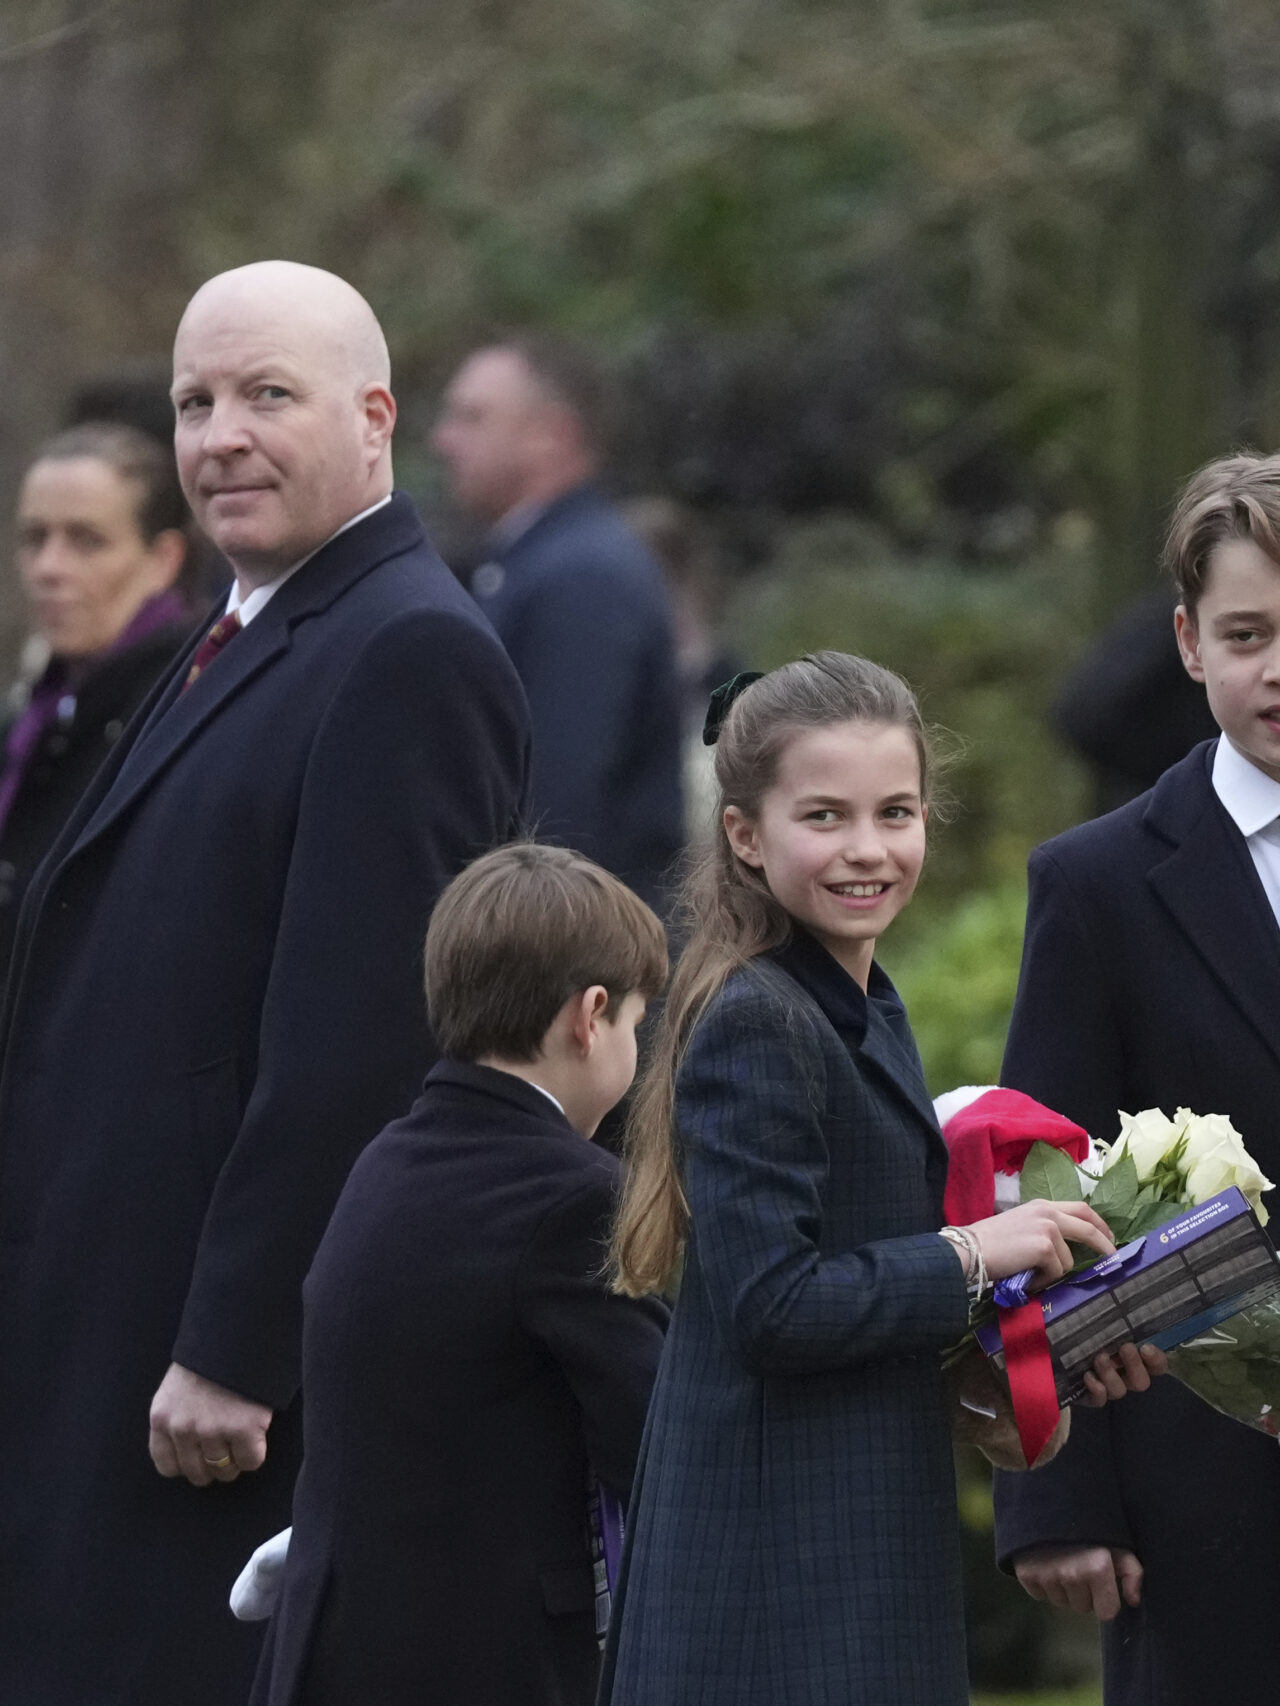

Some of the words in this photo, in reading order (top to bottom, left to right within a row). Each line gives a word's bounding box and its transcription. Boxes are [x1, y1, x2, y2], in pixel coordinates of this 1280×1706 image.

[1176, 1219, 1190, 1229] YOUR
[1190, 1202, 1221, 1222] FAVOURITES
[1177, 1226, 1190, 1235] THIS
[1189, 1210, 1218, 1229] SELECTION
[1217, 1204, 1229, 1213] BOX
[1160, 1233, 1169, 1243] 6
